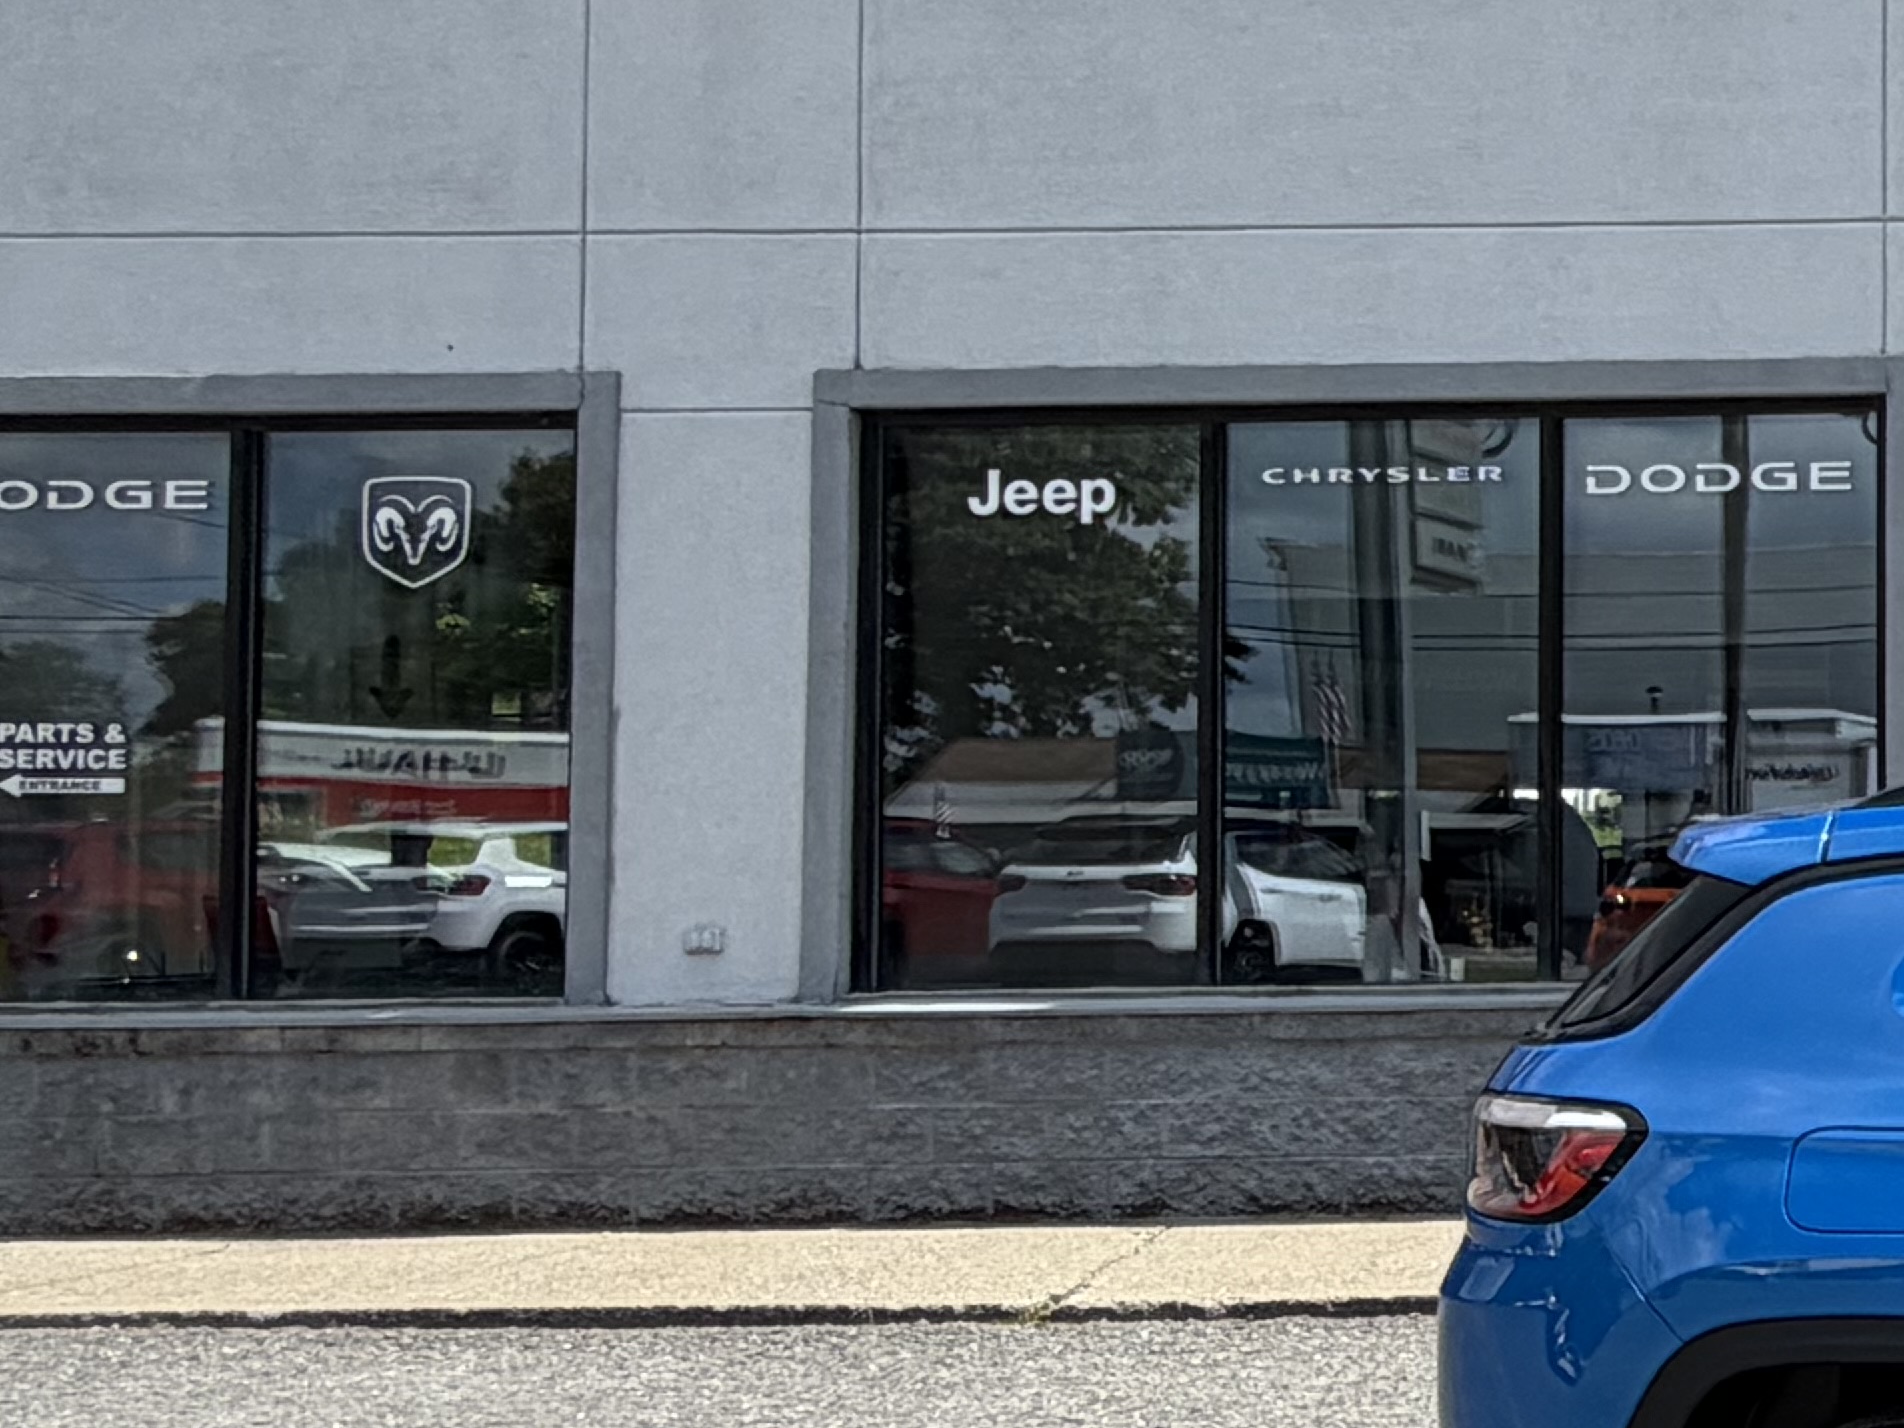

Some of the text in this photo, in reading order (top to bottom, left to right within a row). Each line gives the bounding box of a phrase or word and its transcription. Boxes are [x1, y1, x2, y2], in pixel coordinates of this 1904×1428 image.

[1261, 465, 1503, 484] CHRYSLER
[1586, 461, 1852, 494] DODGE
[0, 480, 209, 510] ODGE
[966, 468, 1116, 525] Jeep
[0, 722, 126, 743] PARTS &
[0, 748, 127, 770] SERVICE
